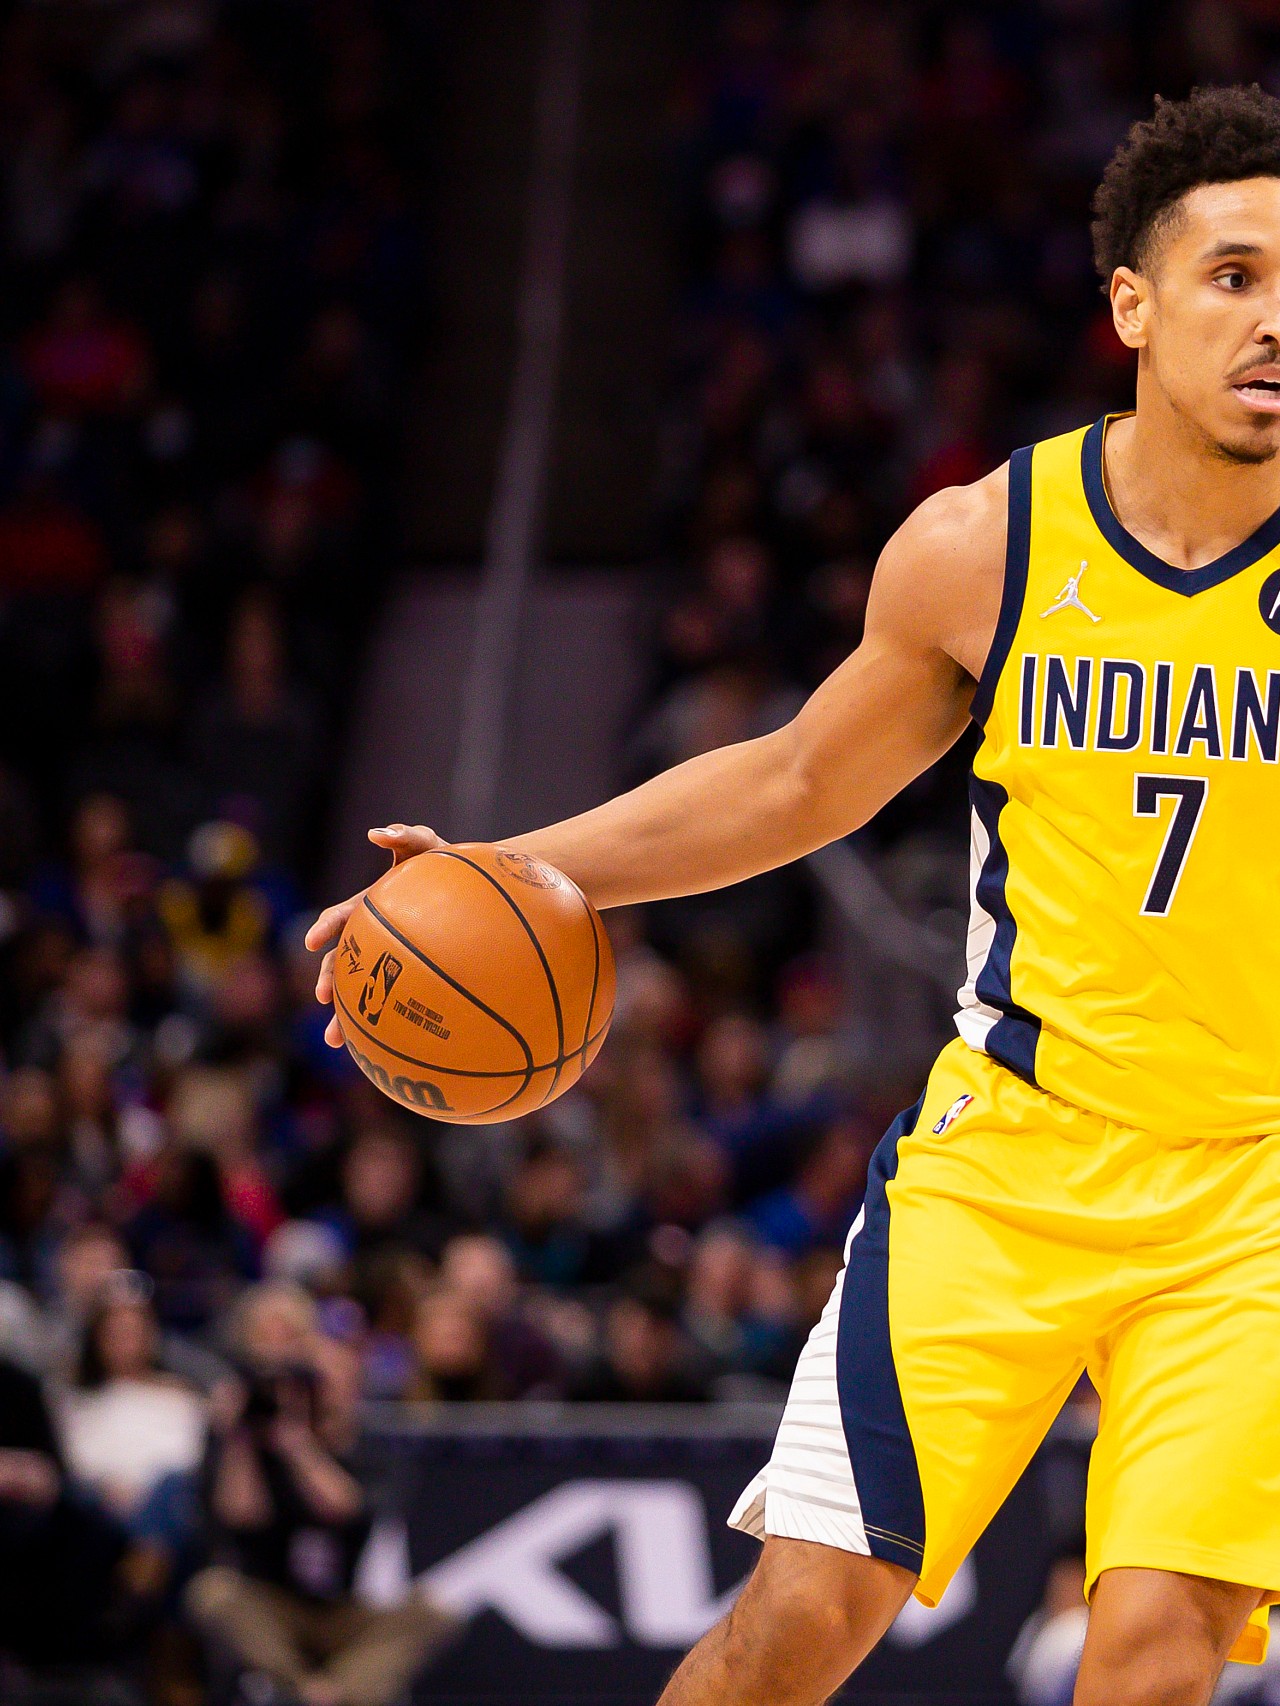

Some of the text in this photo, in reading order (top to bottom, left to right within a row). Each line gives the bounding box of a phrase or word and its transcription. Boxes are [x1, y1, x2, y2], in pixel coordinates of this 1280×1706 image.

[1132, 771, 1210, 917] 7
[393, 999, 451, 1040] OFFICIAL GAME BALL
